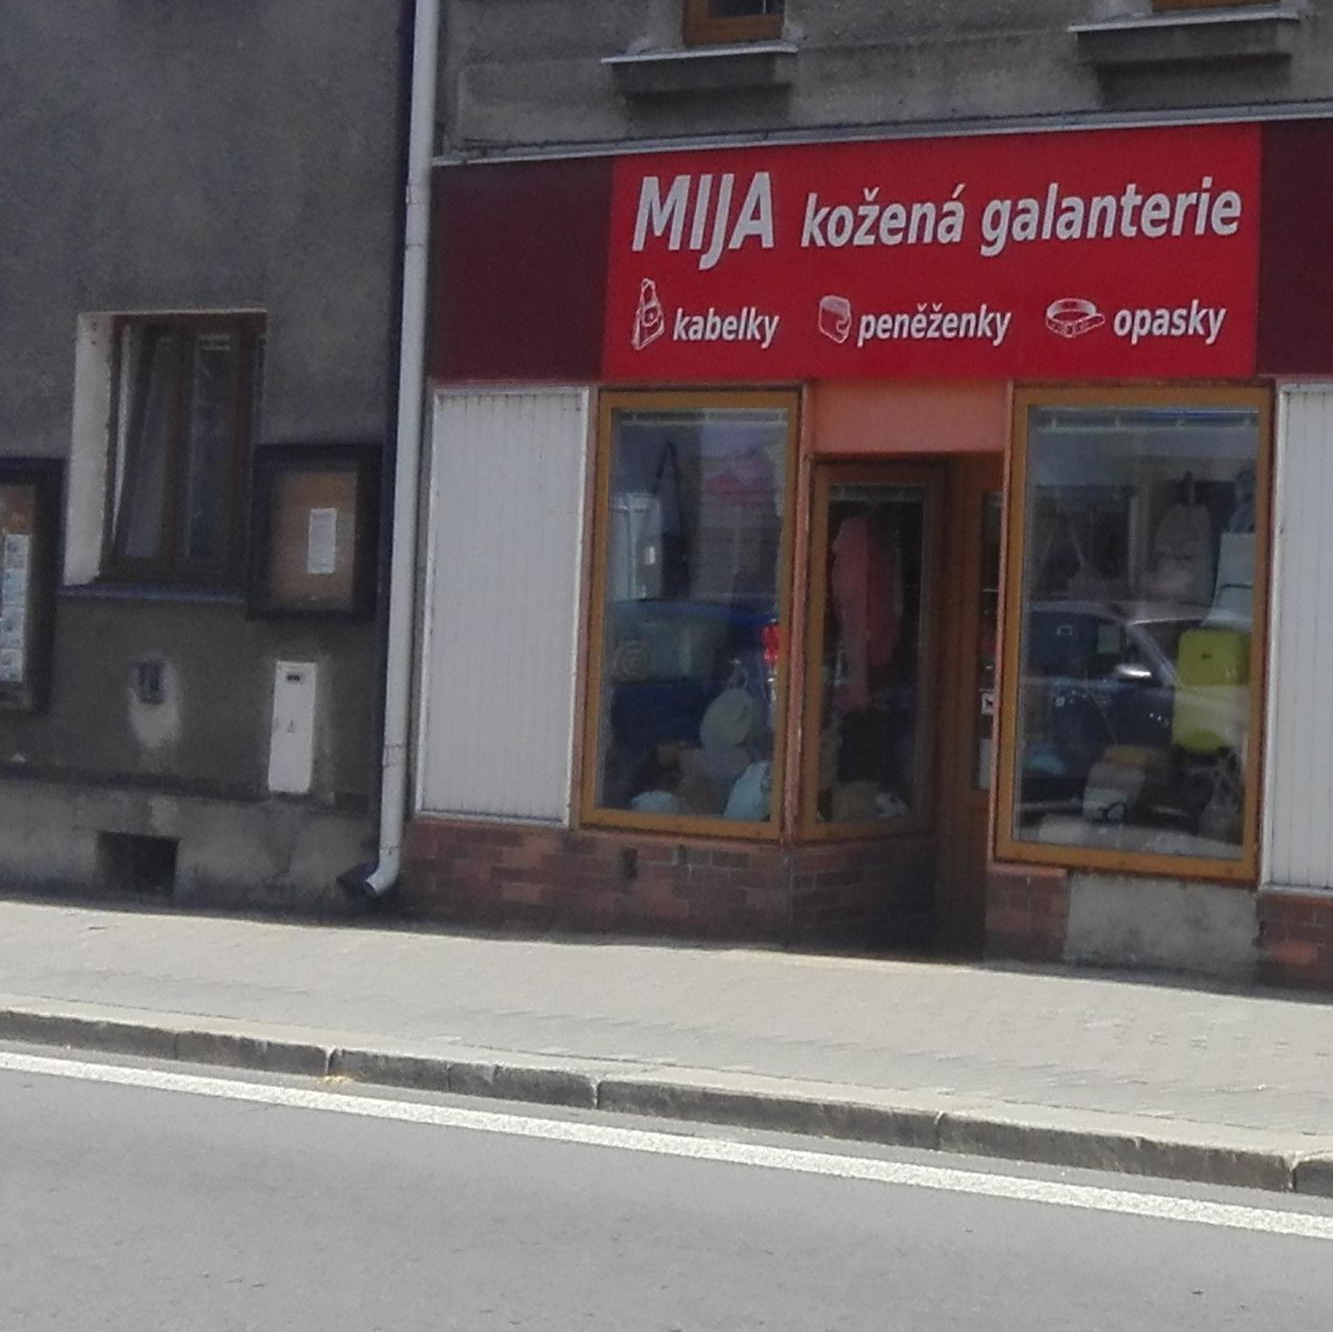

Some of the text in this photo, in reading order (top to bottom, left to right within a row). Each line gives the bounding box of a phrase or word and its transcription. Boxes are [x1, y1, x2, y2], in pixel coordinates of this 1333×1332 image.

[631, 171, 1242, 270] MIJA kožená galanterie
[673, 307, 780, 349] kabelky
[857, 302, 1012, 348] peněženky
[1112, 299, 1227, 346] opasky
